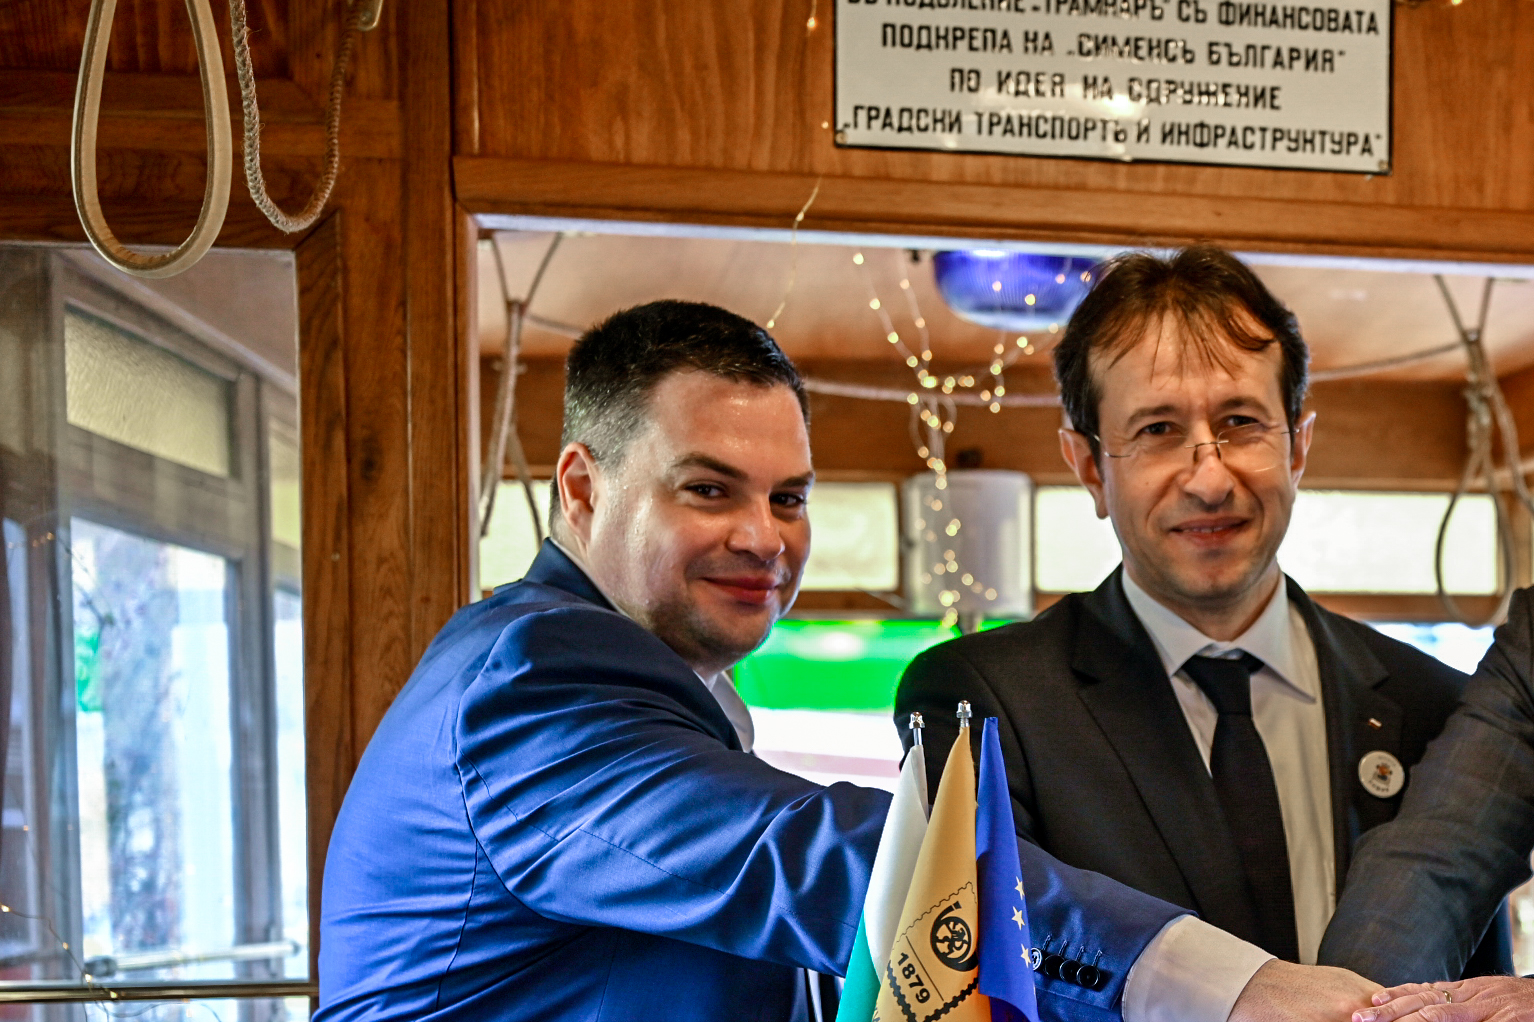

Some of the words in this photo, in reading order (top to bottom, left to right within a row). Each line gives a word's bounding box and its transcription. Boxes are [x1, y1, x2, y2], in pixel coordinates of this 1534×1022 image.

[1177, 0, 1207, 24] СЪ
[1217, 0, 1379, 36] ФИНАНСОВАТА
[1024, 30, 1055, 55] НА
[950, 68, 980, 93] ПО
[997, 70, 1065, 98] ИДЕЯ
[1083, 74, 1113, 100] НА
[1128, 77, 1281, 110] СДРУЖЕНИЕ
[974, 111, 1127, 143] ТРАНСПОРТЪ
[1137, 118, 1150, 144] И
[897, 951, 931, 1004] 1879
